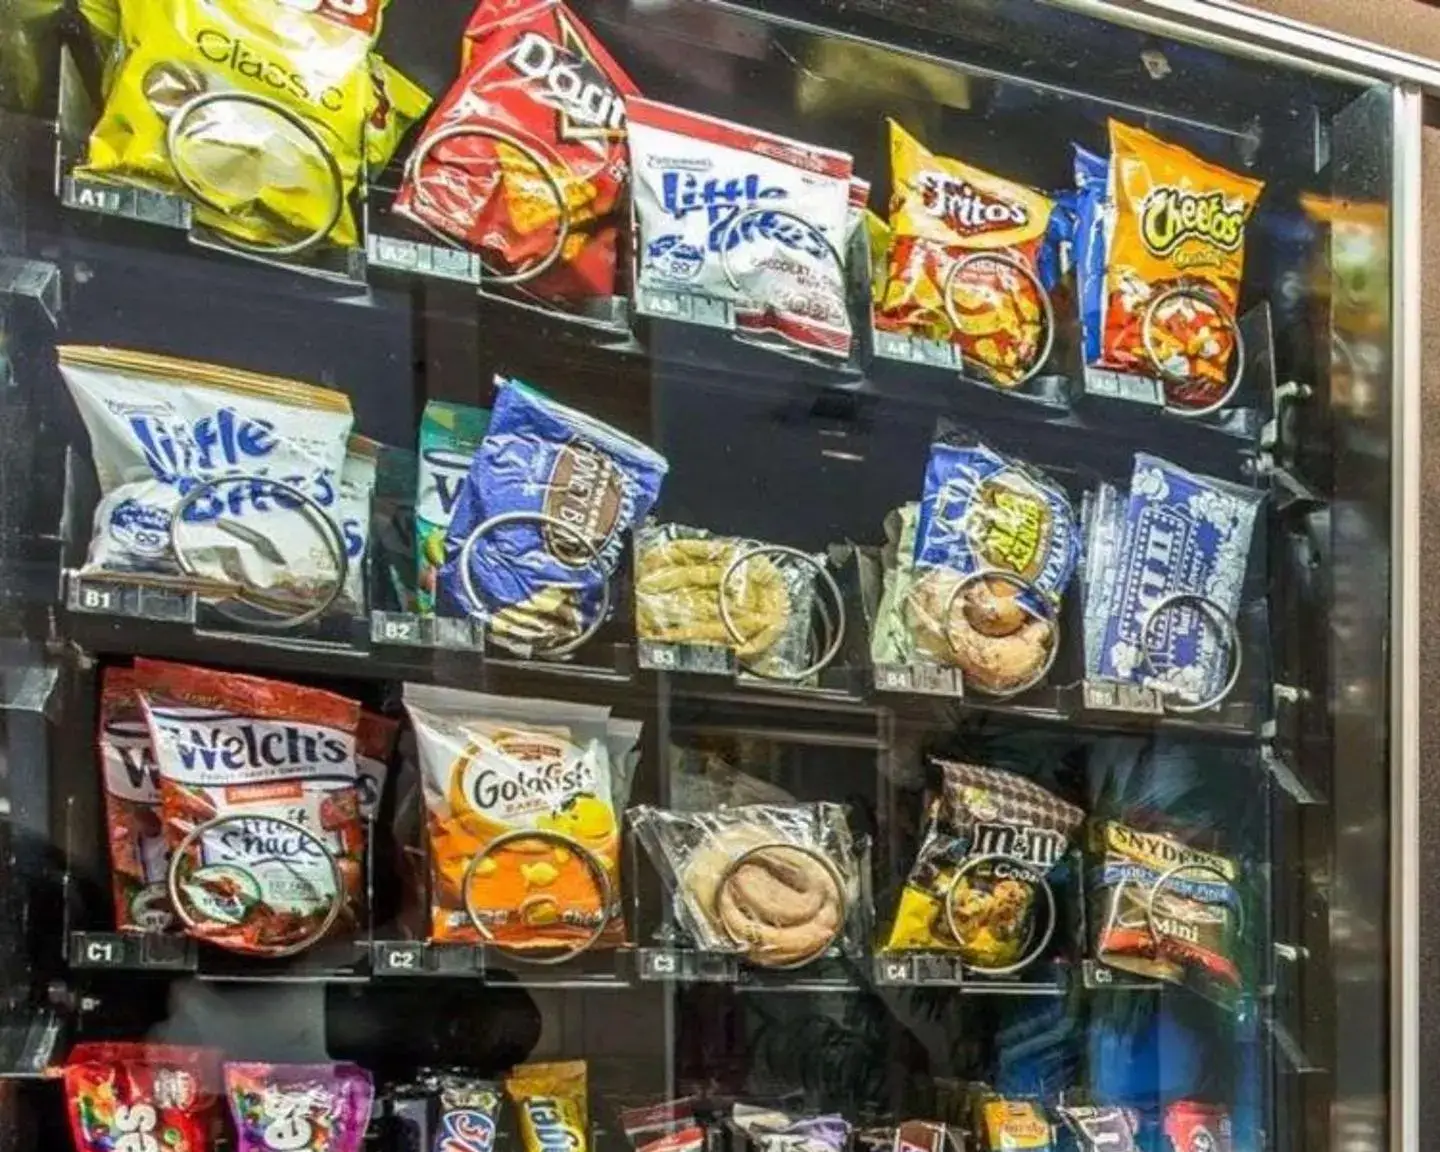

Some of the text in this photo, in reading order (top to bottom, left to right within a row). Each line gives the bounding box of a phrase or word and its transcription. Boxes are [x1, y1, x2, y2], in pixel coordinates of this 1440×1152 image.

[196, 28, 345, 112] Classic
[79, 189, 104, 207] A1
[662, 172, 788, 220] Little
[919, 172, 1028, 229] Fritos
[1142, 187, 1243, 252] Cheetos
[129, 407, 277, 485] Little
[86, 590, 110, 607] B1
[385, 620, 411, 639] B2
[159, 724, 349, 771] Welch's
[473, 761, 592, 809] Goldfish
[1151, 917, 1200, 944] Mini
[87, 943, 113, 960] C1
[389, 952, 415, 969] C2
[653, 957, 675, 972] C3
